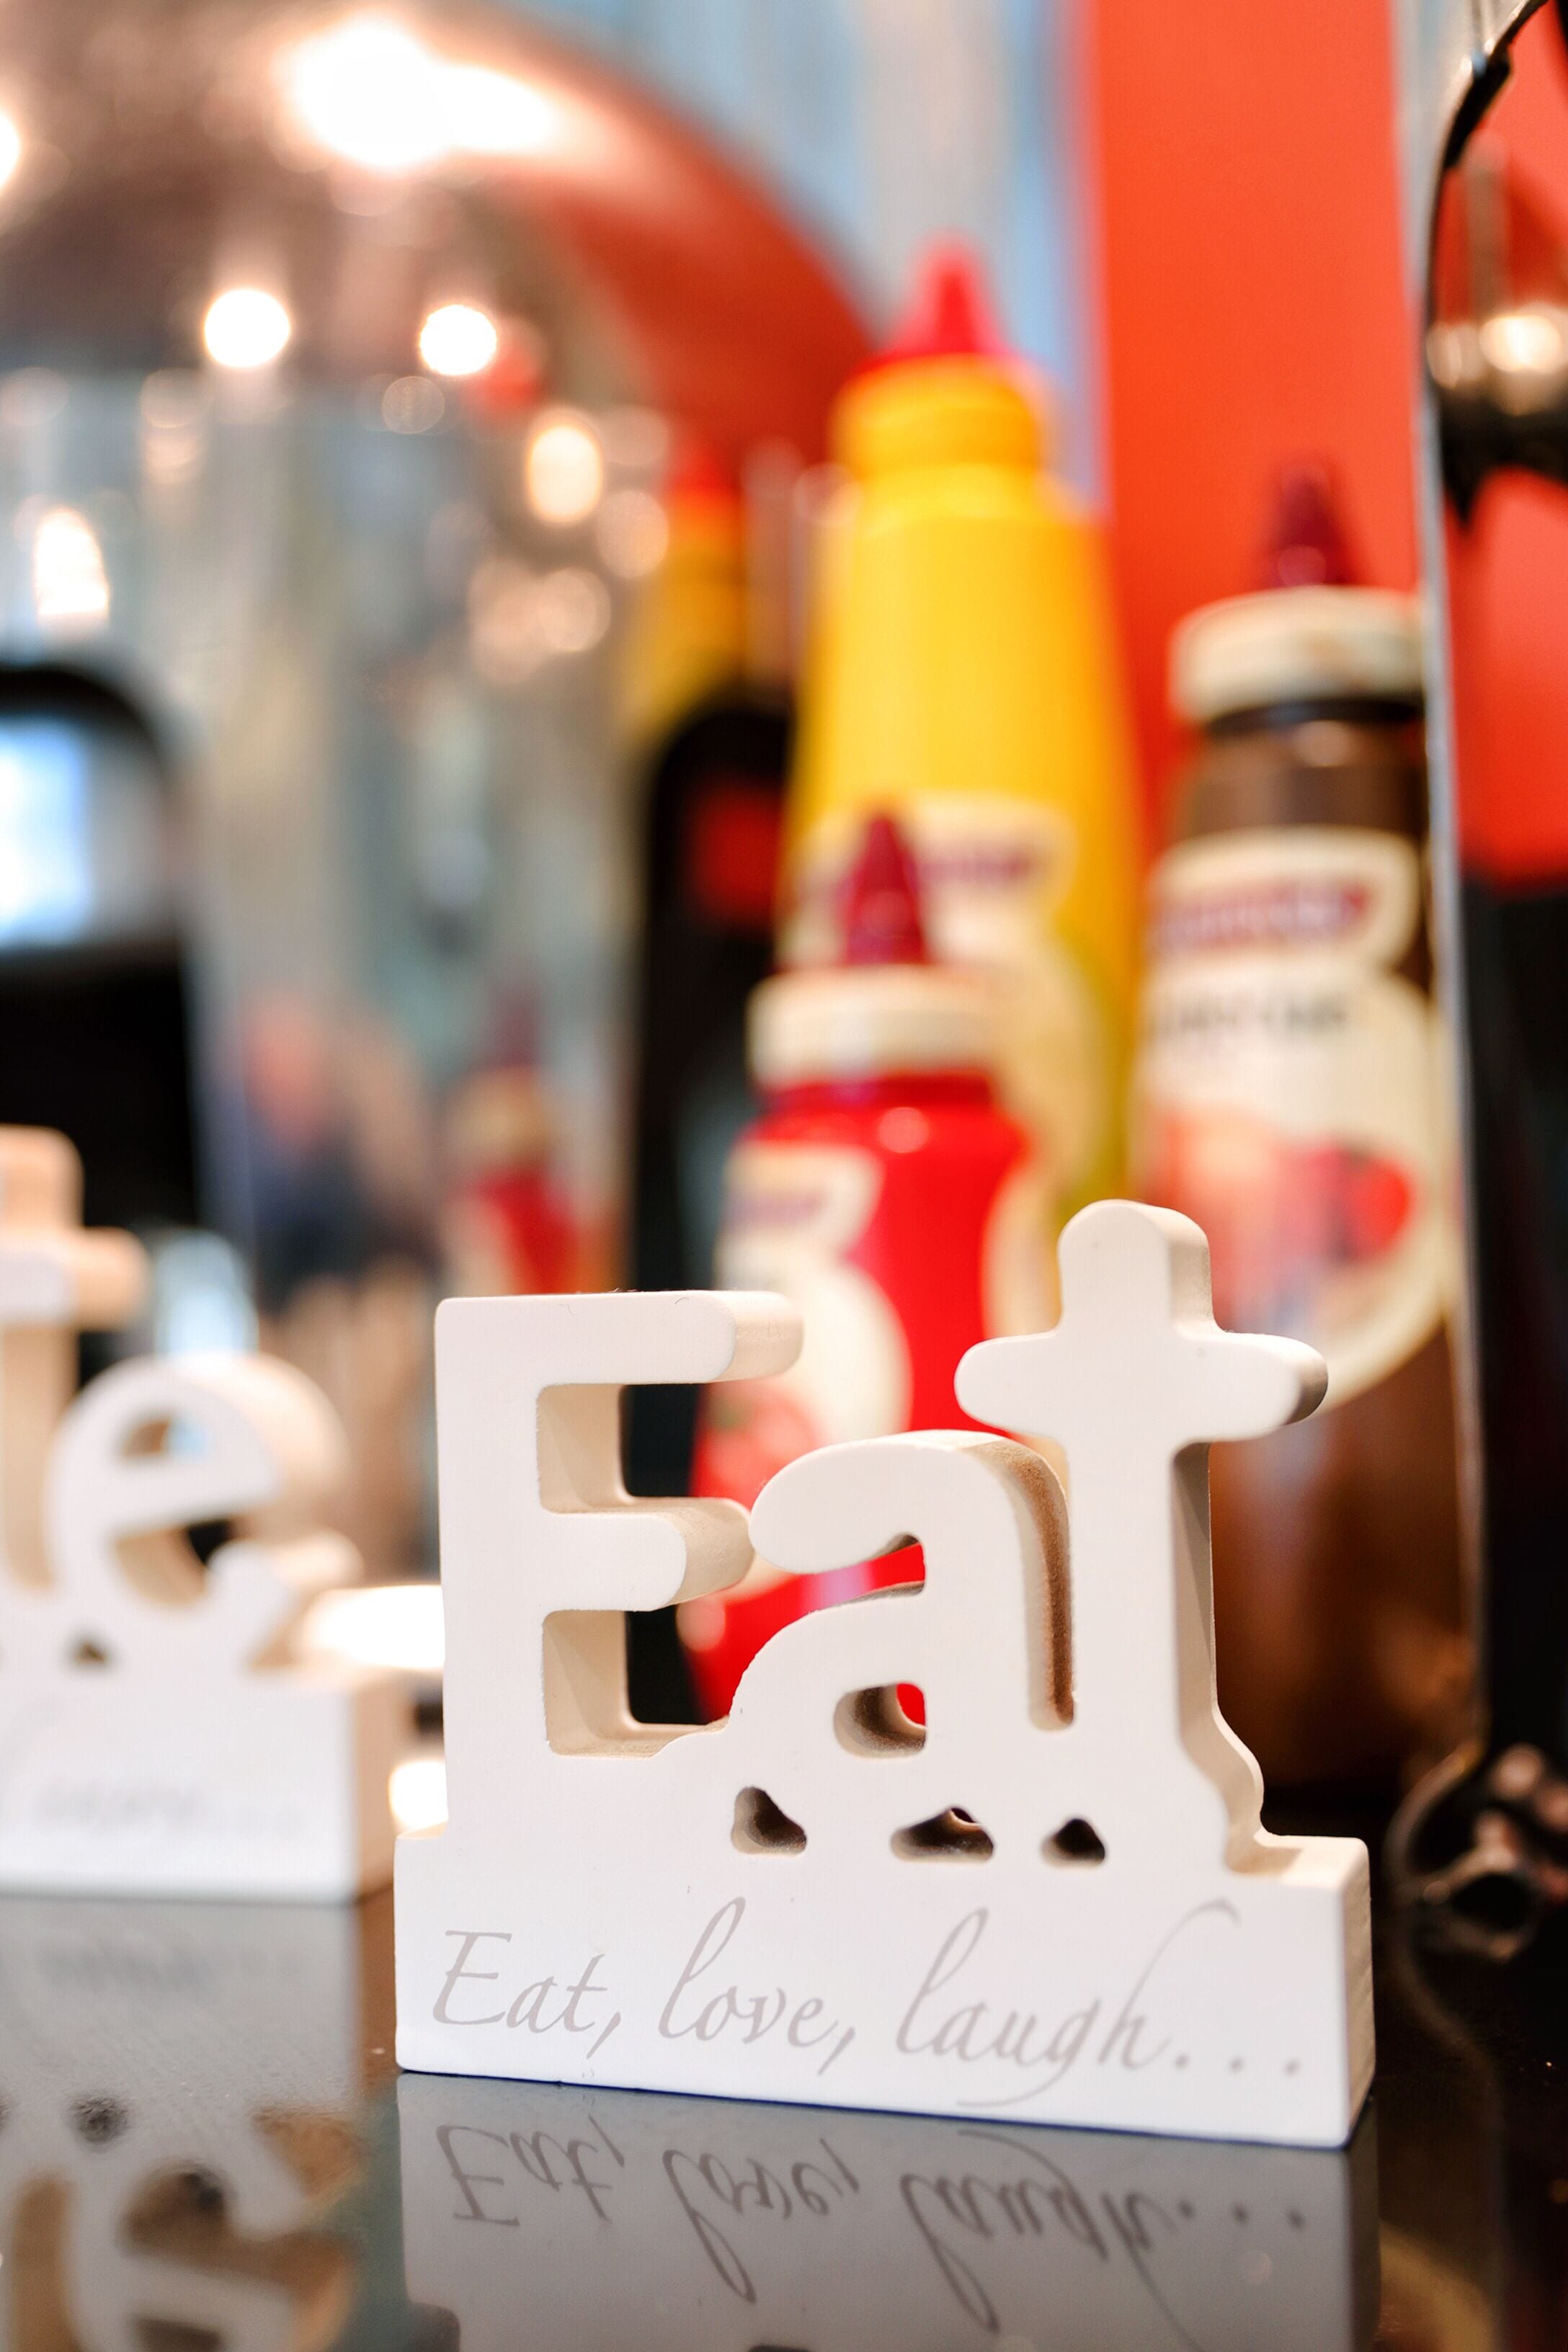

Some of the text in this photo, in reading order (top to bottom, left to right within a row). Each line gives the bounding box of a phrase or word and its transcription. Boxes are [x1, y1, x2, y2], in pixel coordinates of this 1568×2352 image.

[434, 1201, 1328, 1801] Eat
[432, 1929, 621, 2059] Eat,
[657, 1896, 856, 2076] love,
